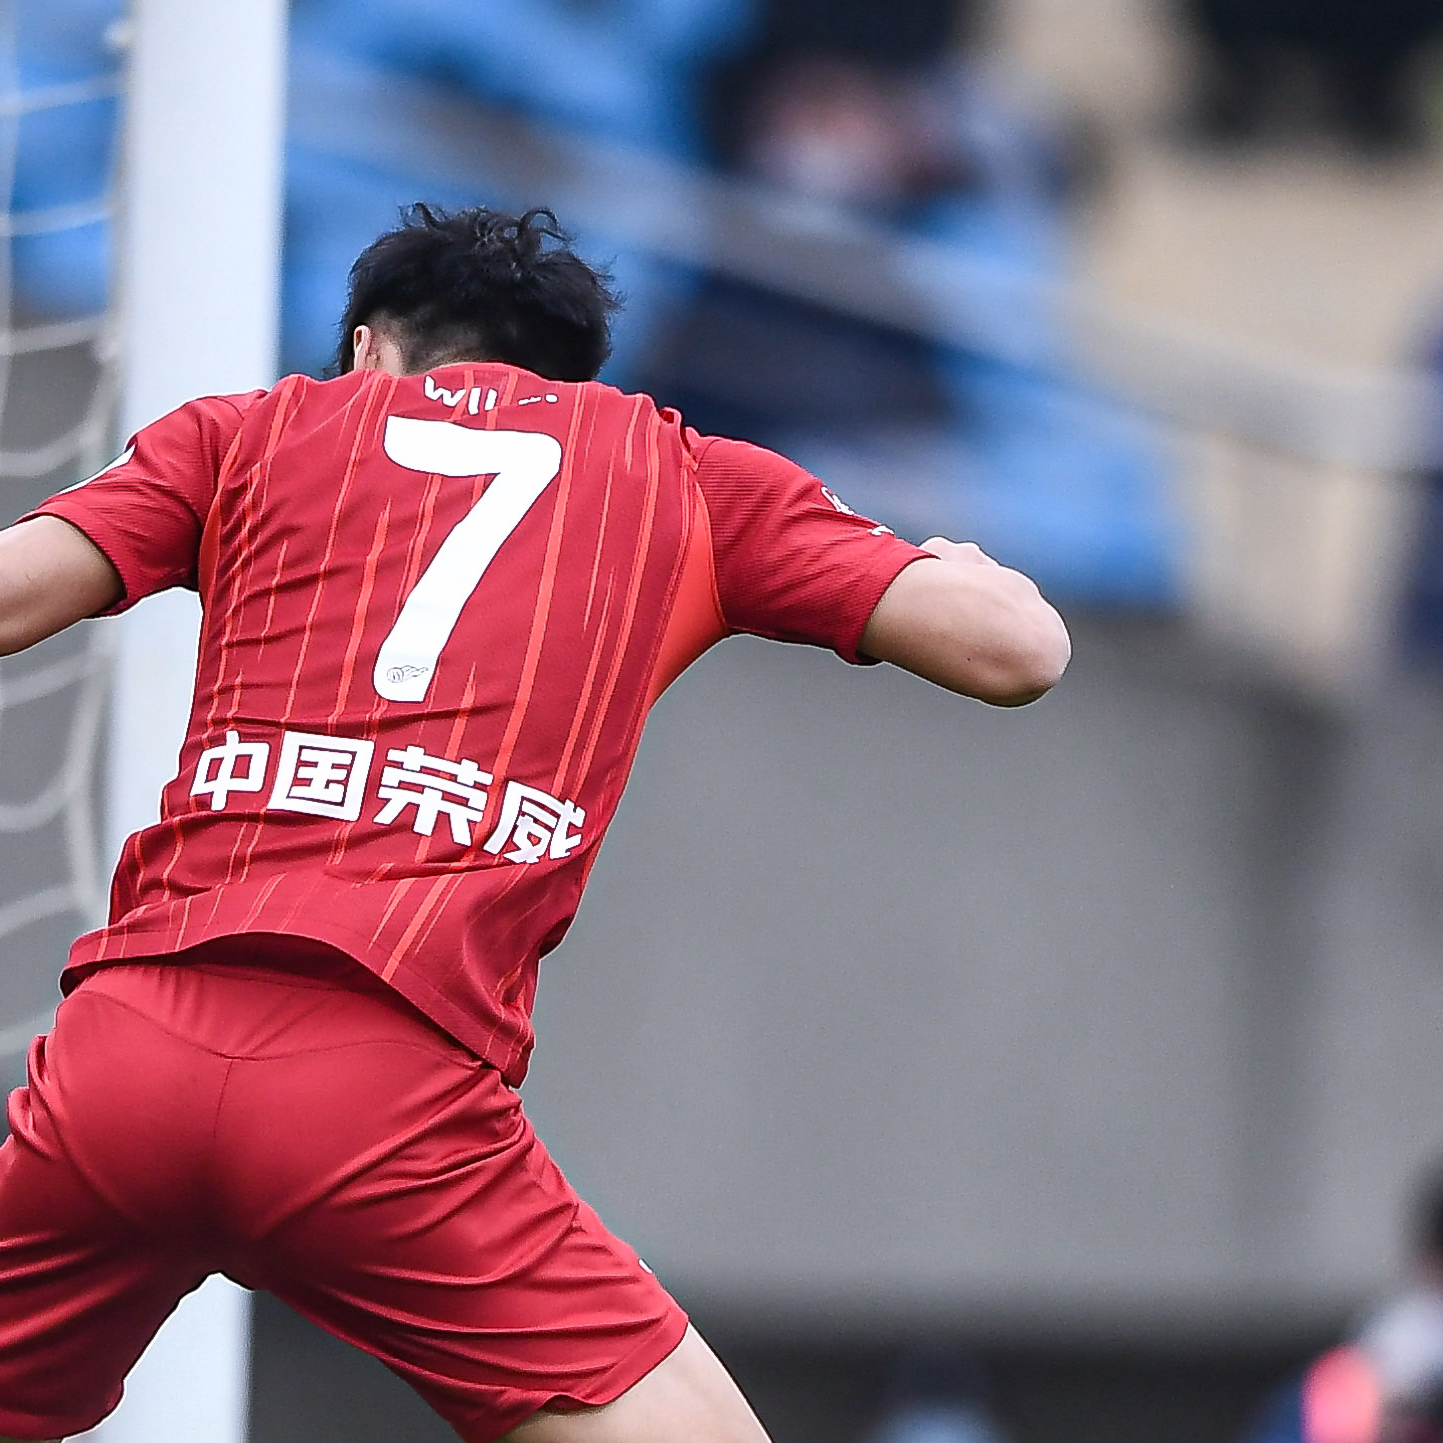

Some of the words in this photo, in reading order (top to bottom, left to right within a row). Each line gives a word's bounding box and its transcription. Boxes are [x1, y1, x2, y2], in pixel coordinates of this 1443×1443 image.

[373, 415, 563, 702] 7
[189, 730, 586, 864] 中国荣威
